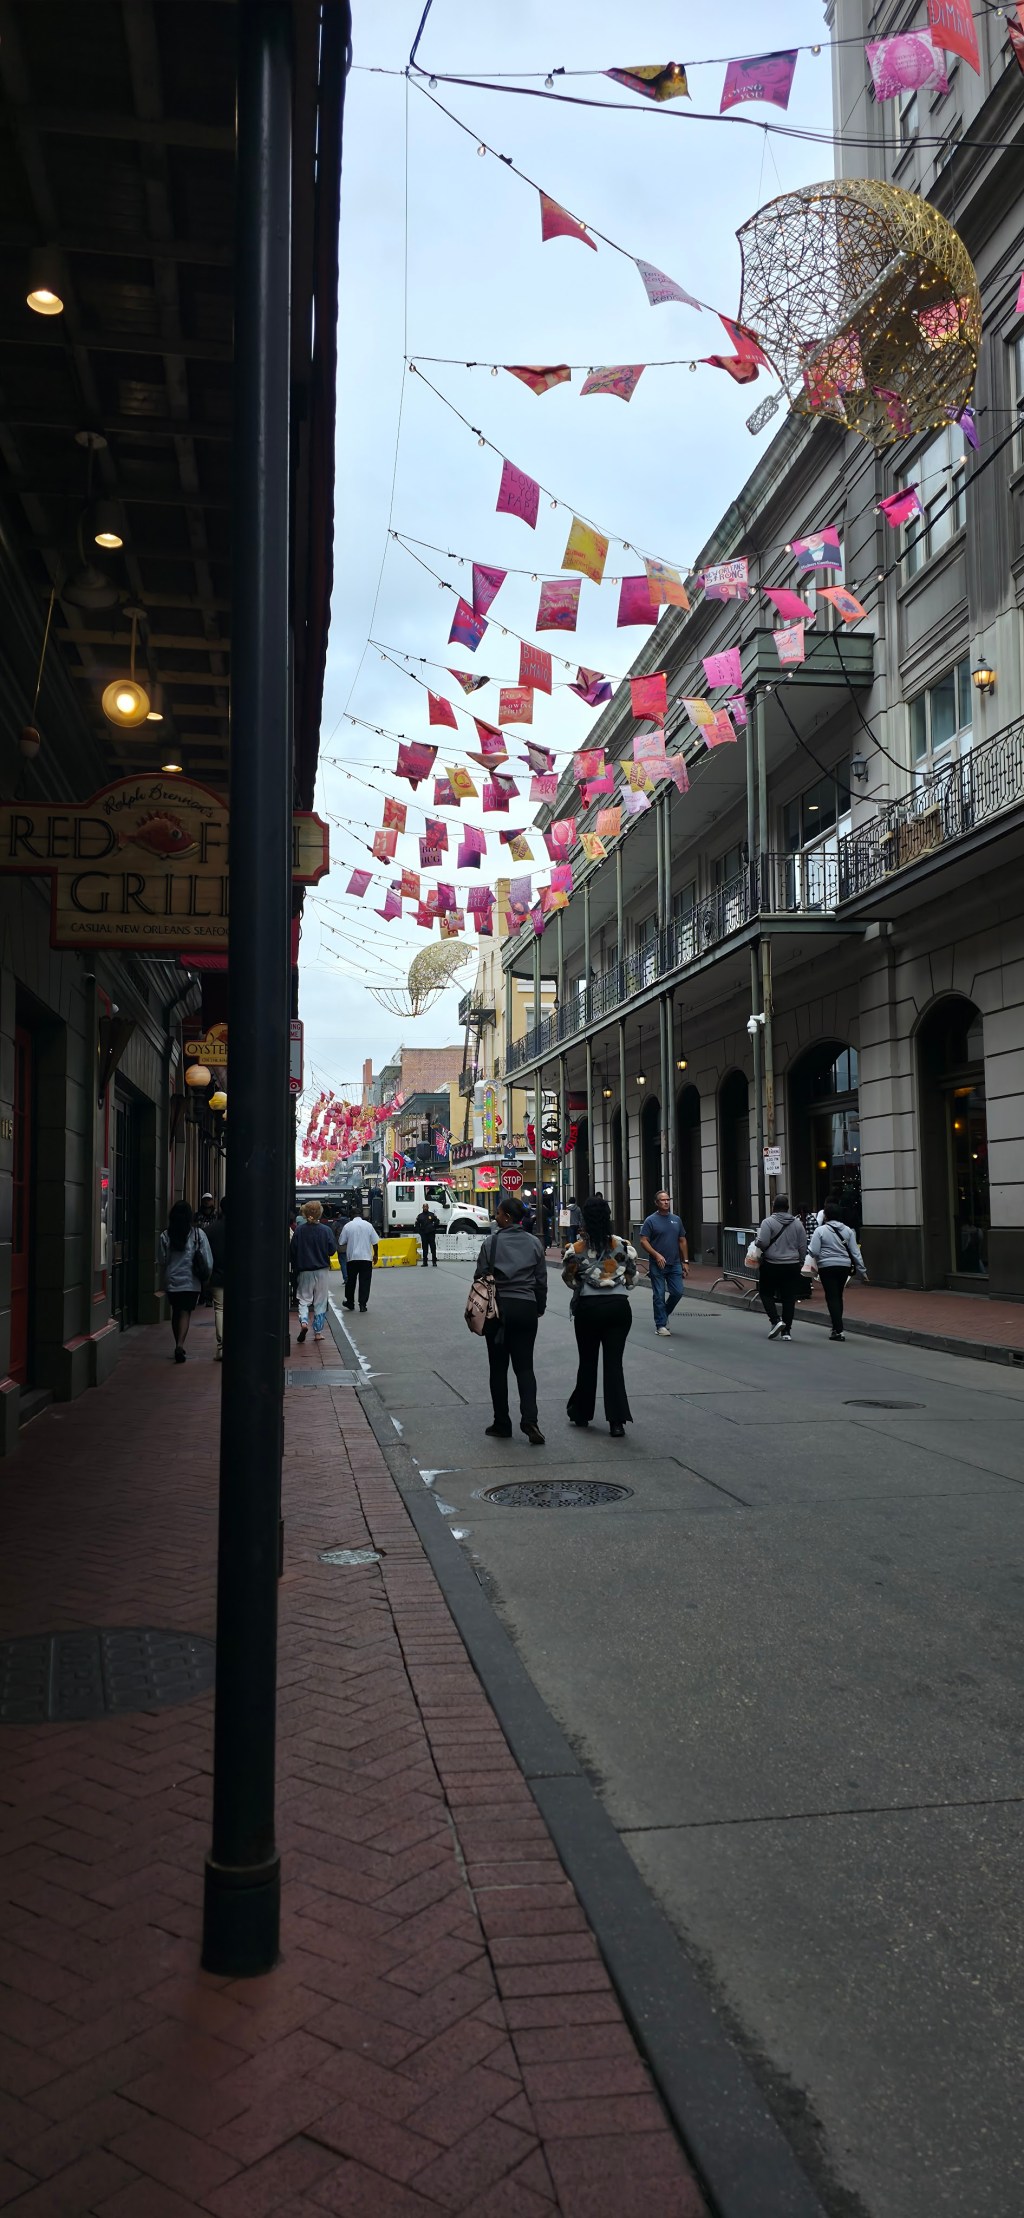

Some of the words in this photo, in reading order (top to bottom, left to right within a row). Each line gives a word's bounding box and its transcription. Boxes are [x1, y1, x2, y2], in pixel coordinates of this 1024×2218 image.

[740, 91, 763, 101] YOU
[508, 492, 538, 519] PAPA
[706, 569, 744, 584] STRONG
[8, 815, 116, 860] RED
[71, 922, 112, 934] CASUAL
[115, 923, 140, 934] NEW
[142, 924, 191, 935] ORLEANS
[503, 1176, 521, 1184] STOP
